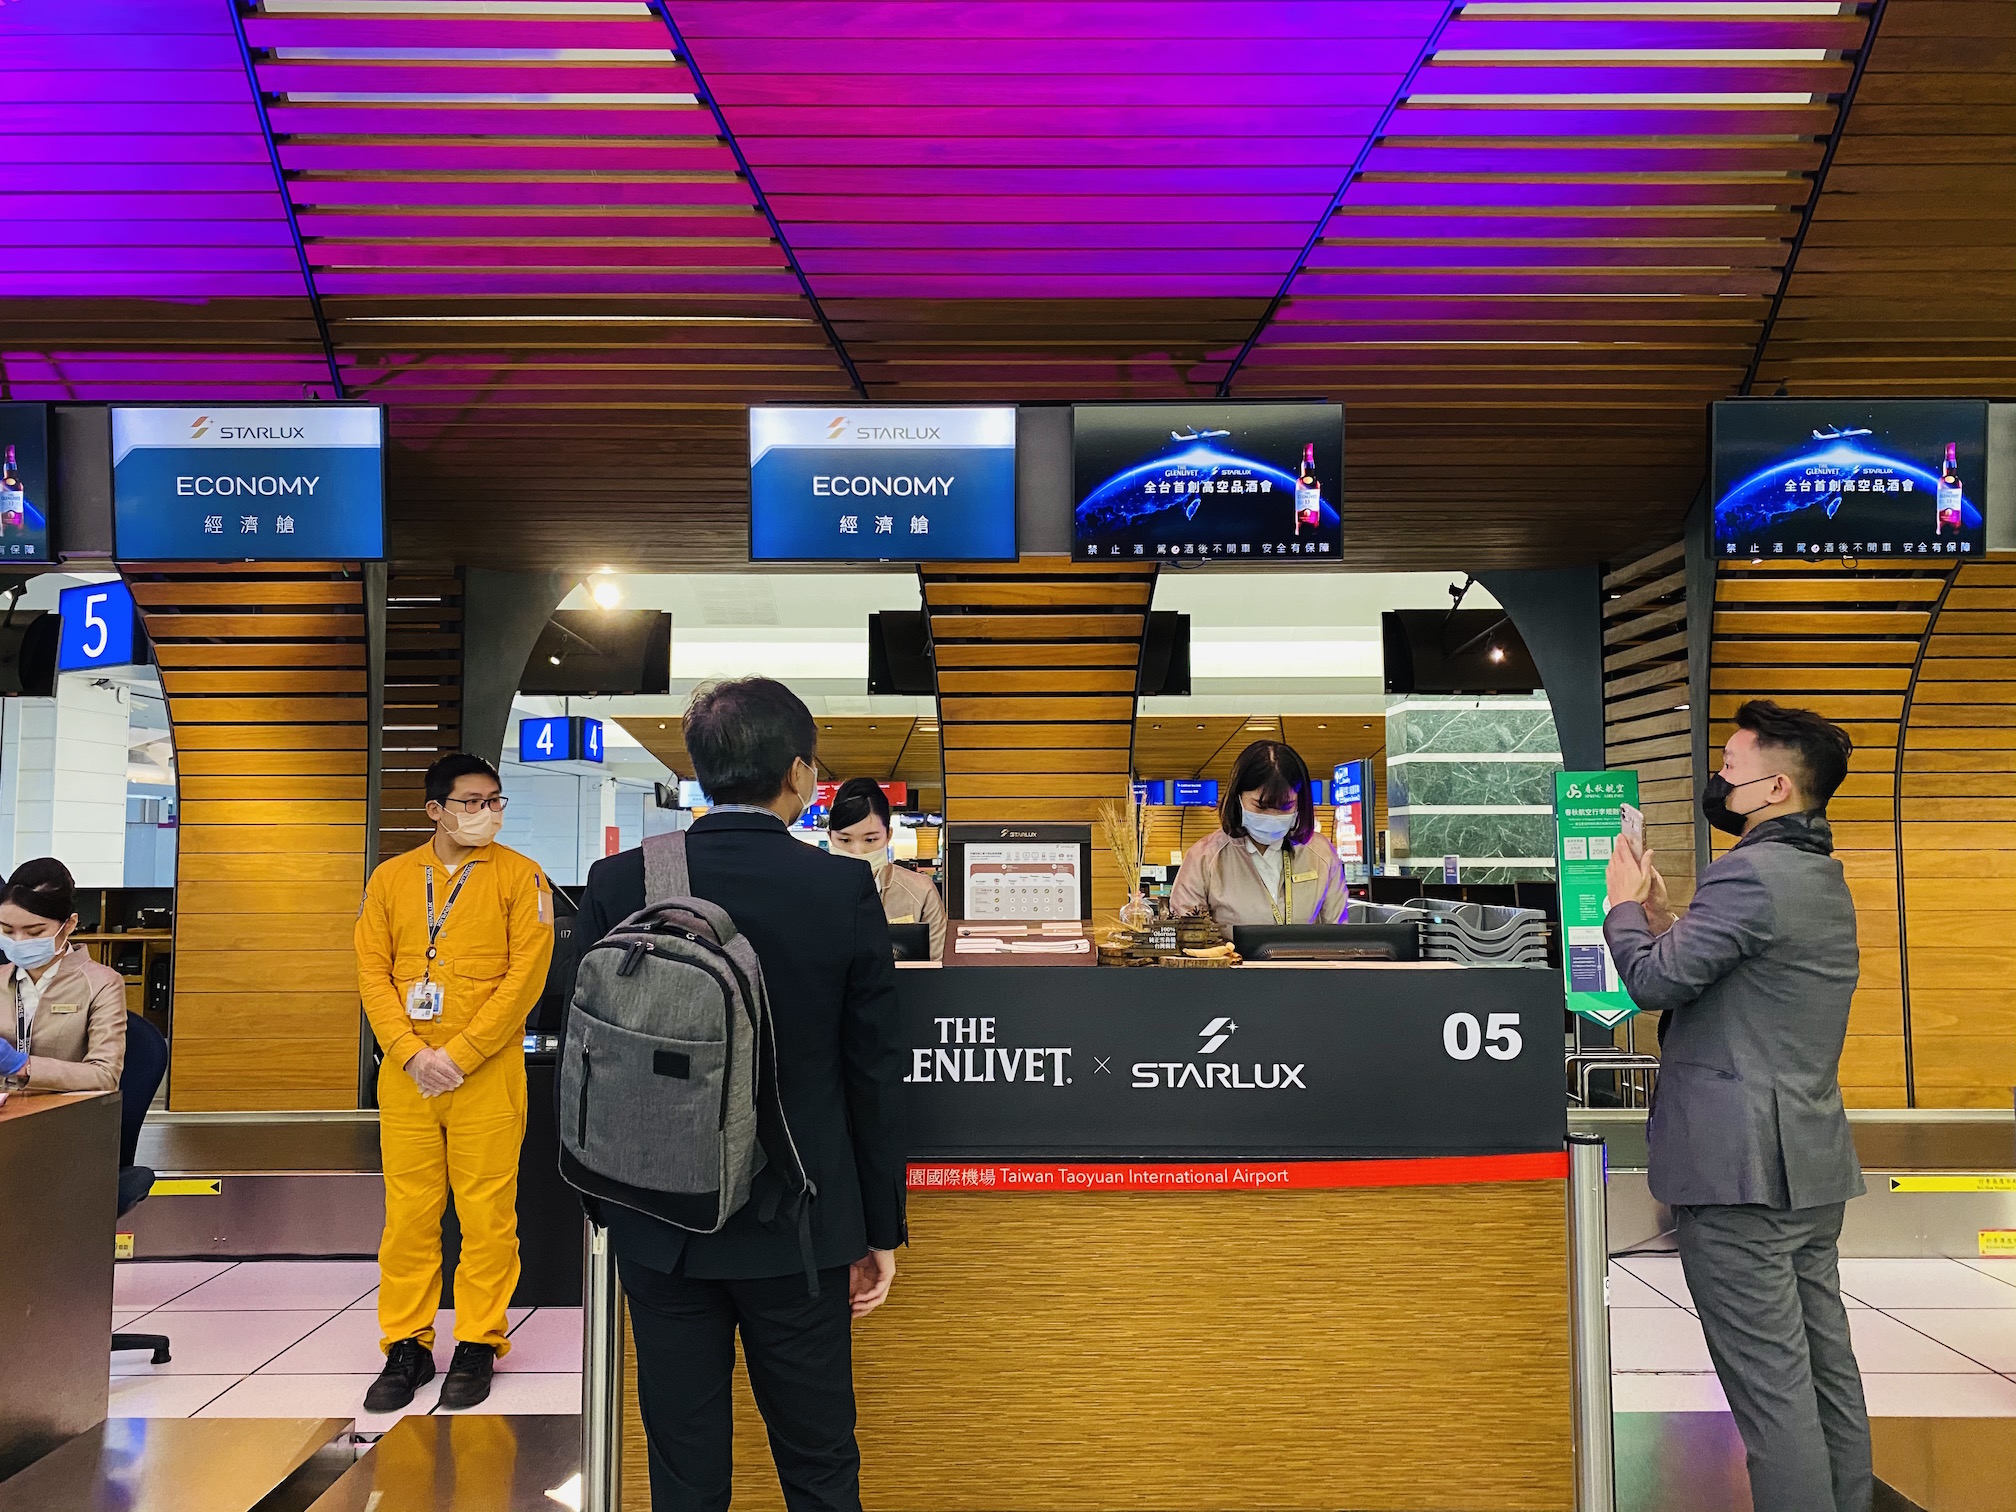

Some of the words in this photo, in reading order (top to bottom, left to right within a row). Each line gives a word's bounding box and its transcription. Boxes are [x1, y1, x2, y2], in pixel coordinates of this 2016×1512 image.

[220, 427, 305, 439] STARLUX
[856, 427, 941, 440] STARLUX
[1164, 468, 1199, 477] GLENLIVET
[1805, 468, 1840, 476] GLENLIVET
[176, 476, 320, 496] ECONOMY
[812, 476, 955, 497] ECONOMY
[1143, 479, 1273, 494] 全台首創高空品酒會
[1784, 478, 1915, 493] 全台首創高空品酒會
[204, 515, 295, 534] 經濟艙
[839, 515, 929, 535] 經濟艙
[82, 593, 108, 658] 5
[536, 723, 554, 756] 4
[589, 725, 598, 756] 4
[560, 930, 571, 938] 07
[934, 1017, 996, 1044] THE
[1443, 1012, 1523, 1061] 05
[903, 1047, 1073, 1087] ENLIVET.
[1131, 1062, 1307, 1089] STARLUX
[906, 1168, 996, 1186] 園國際機場
[1000, 1167, 1054, 1184] Taiwan
[1057, 1168, 1124, 1187] Taoyuan
[1129, 1168, 1229, 1184] International
[1232, 1168, 1289, 1186] Airport
